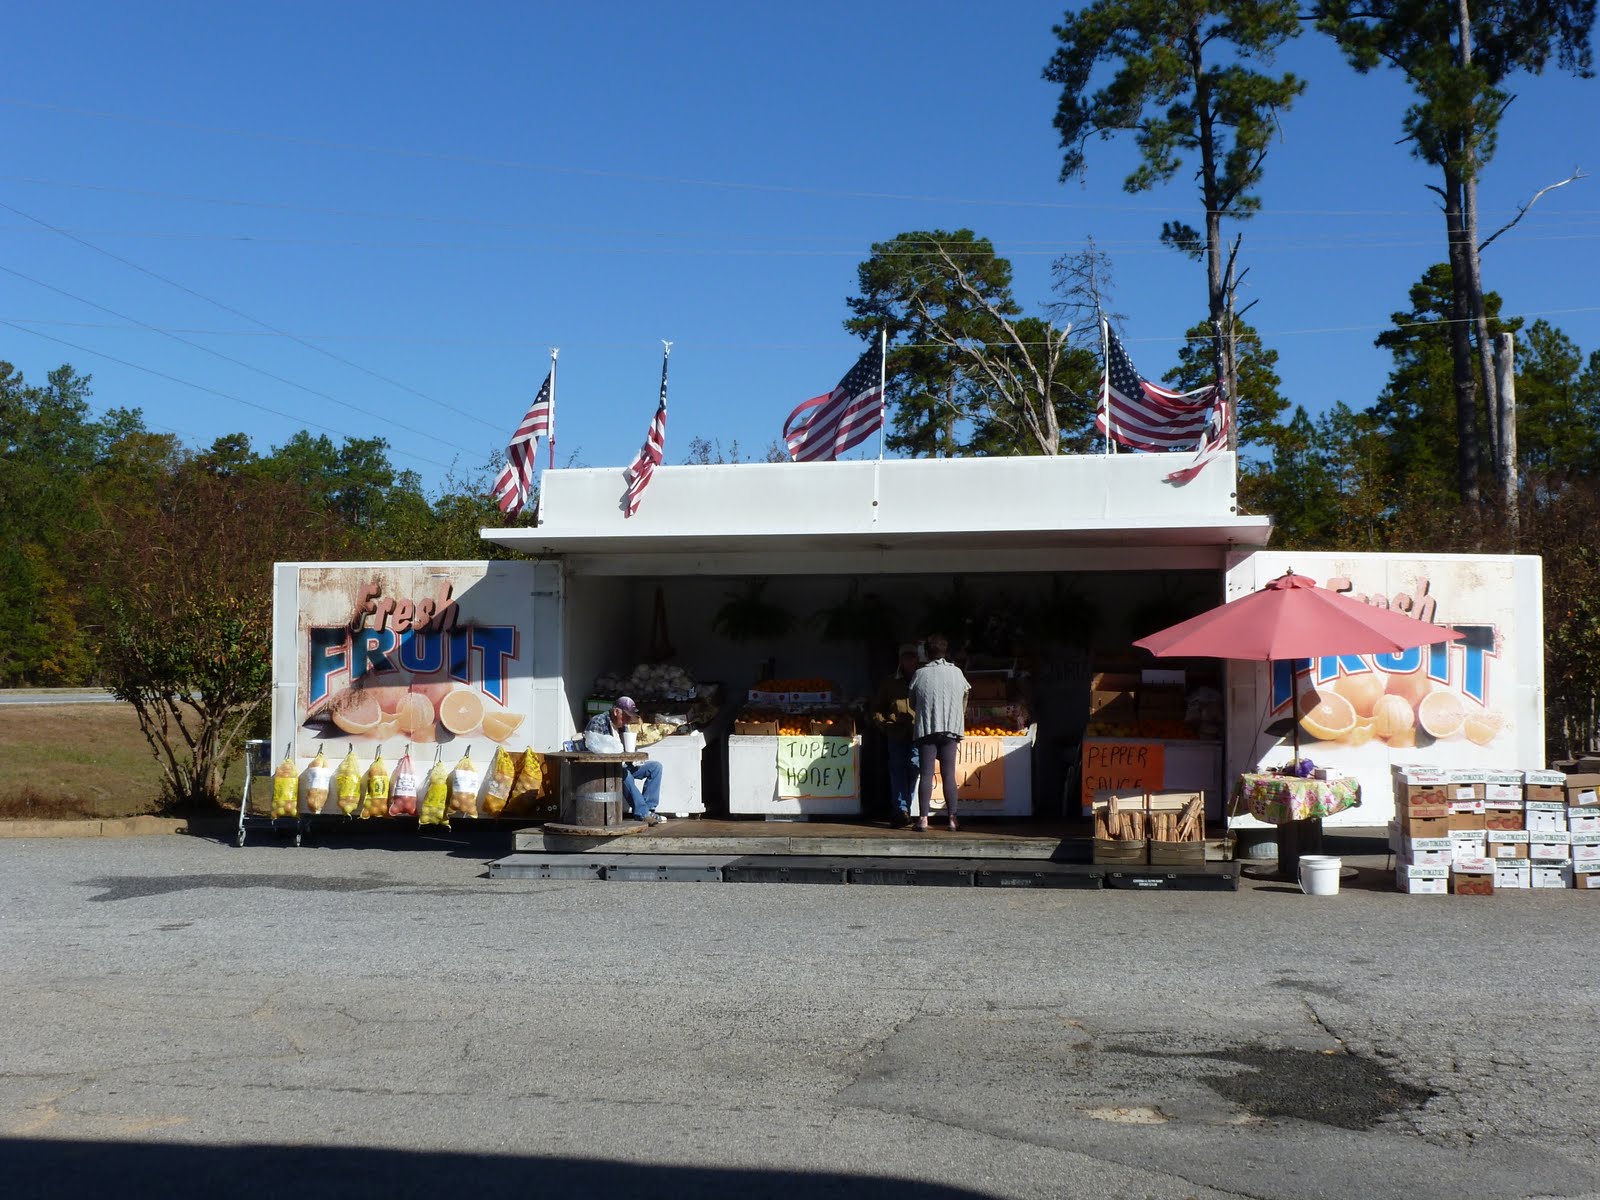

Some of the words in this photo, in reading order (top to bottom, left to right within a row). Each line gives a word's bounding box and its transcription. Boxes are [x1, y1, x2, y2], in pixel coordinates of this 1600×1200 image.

[351, 581, 460, 633] Fresh
[306, 624, 520, 713] FRUIT
[787, 741, 849, 759] TUPELO
[1087, 746, 1149, 768] PEPPER
[786, 767, 846, 790] HONEY
